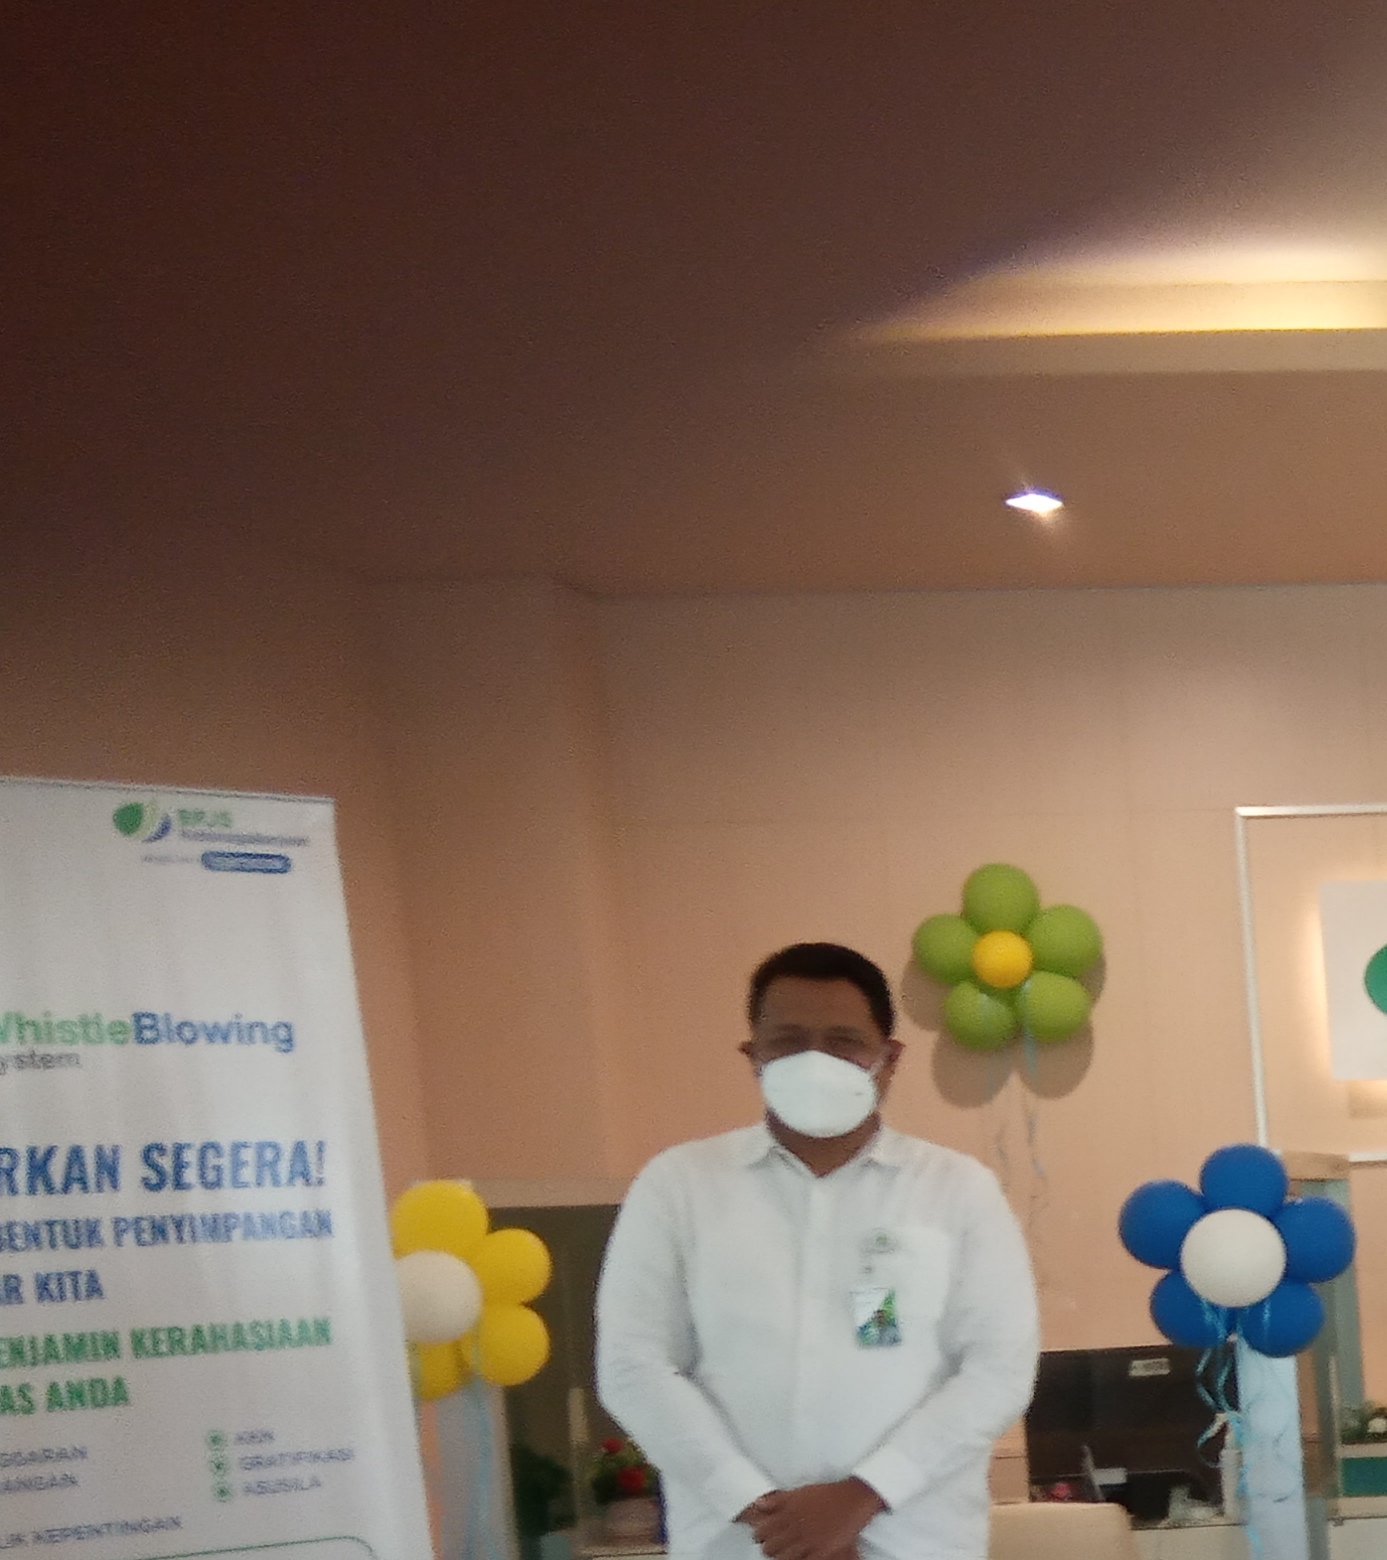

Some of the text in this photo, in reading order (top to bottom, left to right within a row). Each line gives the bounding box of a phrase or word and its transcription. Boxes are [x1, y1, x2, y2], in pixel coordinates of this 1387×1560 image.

[140, 1140, 327, 1192] SEGERA!
[112, 1209, 334, 1248] PENYIMPANGAN
[34, 1269, 105, 1303] KITA
[130, 1316, 332, 1359] KERAHASIAAN
[46, 1376, 130, 1413] ANDA
